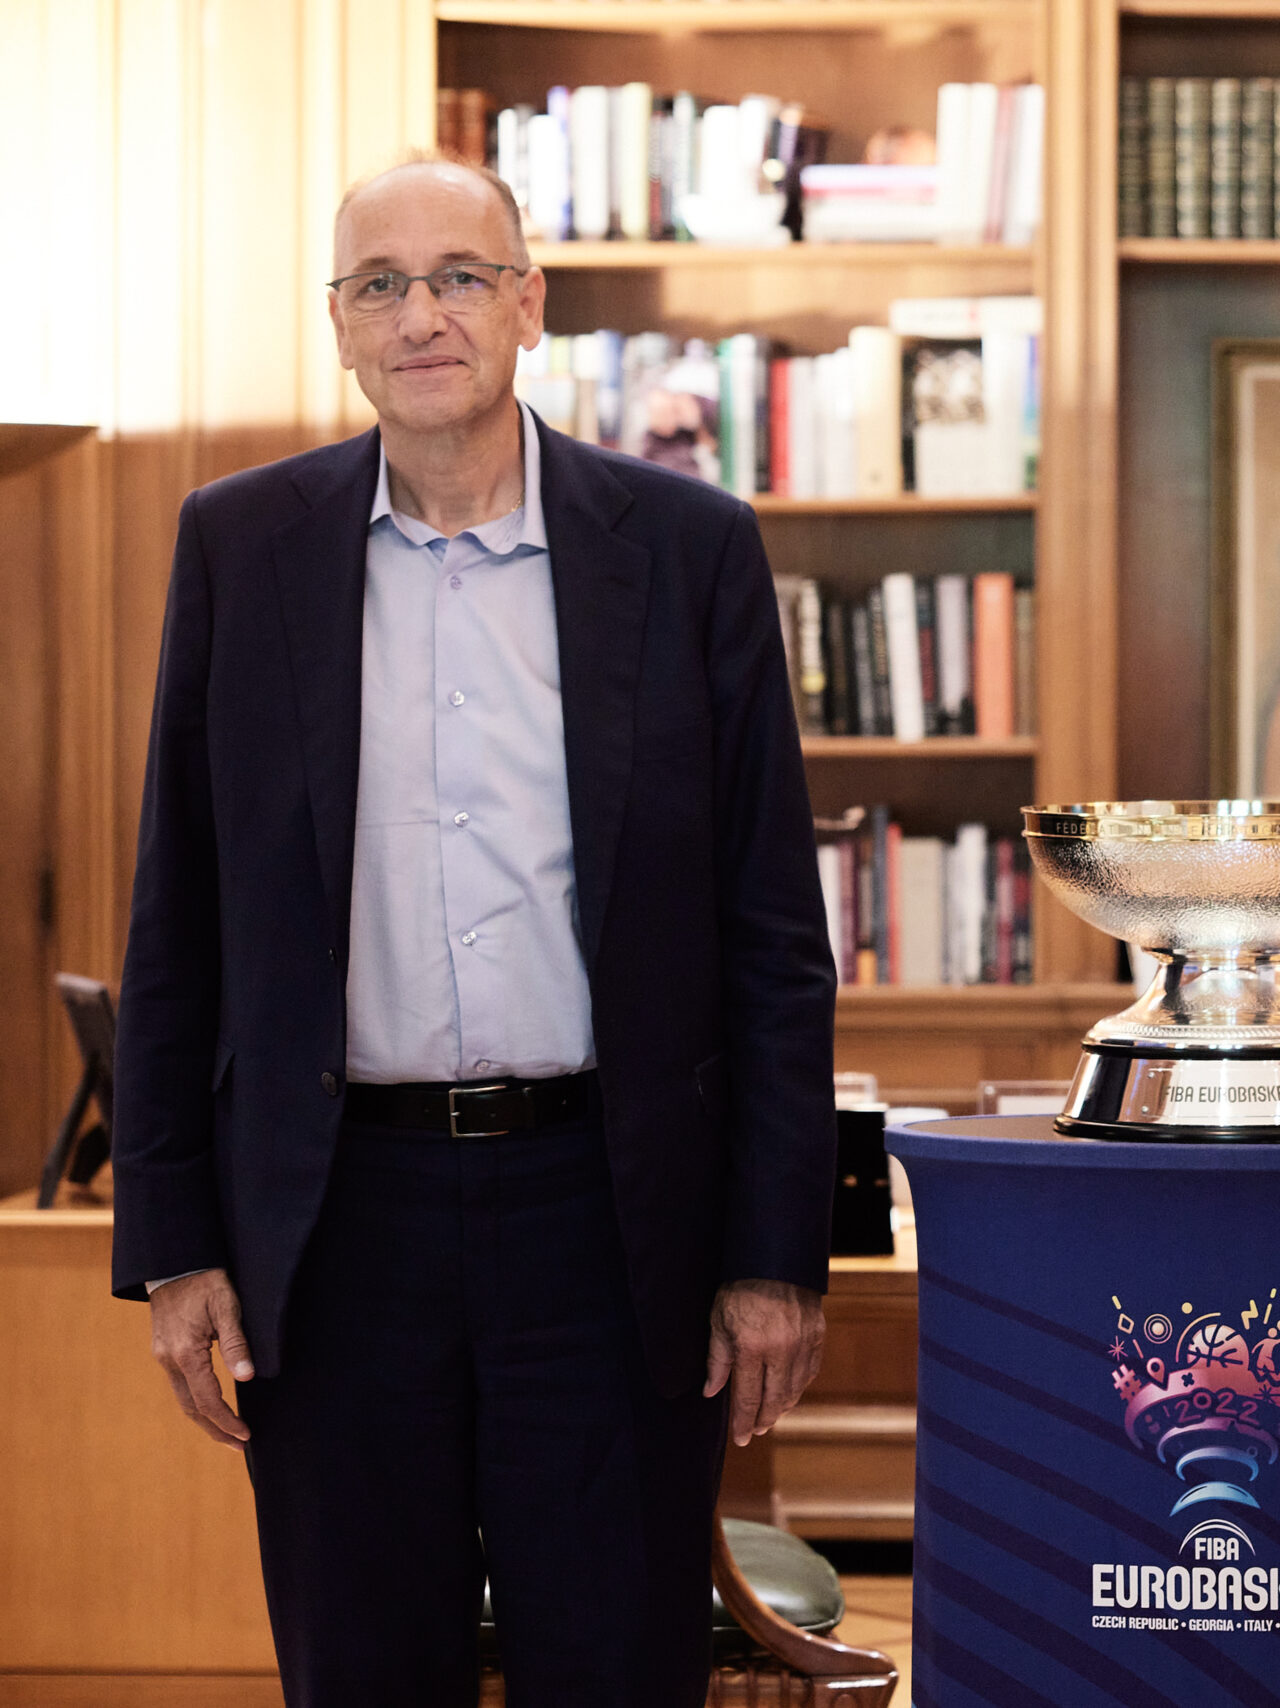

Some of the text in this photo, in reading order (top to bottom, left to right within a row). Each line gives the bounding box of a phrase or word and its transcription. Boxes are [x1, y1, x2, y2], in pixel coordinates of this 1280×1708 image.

[1164, 1086, 1194, 1103] FIBA
[1174, 1391, 1260, 1426] 2022
[1194, 1537, 1240, 1561] FIBA
[1091, 1615, 1126, 1629] CZECH
[1128, 1616, 1179, 1631] REPUBLIC
[1188, 1618, 1235, 1632] GEORGIA
[1243, 1619, 1274, 1632] ITALY
